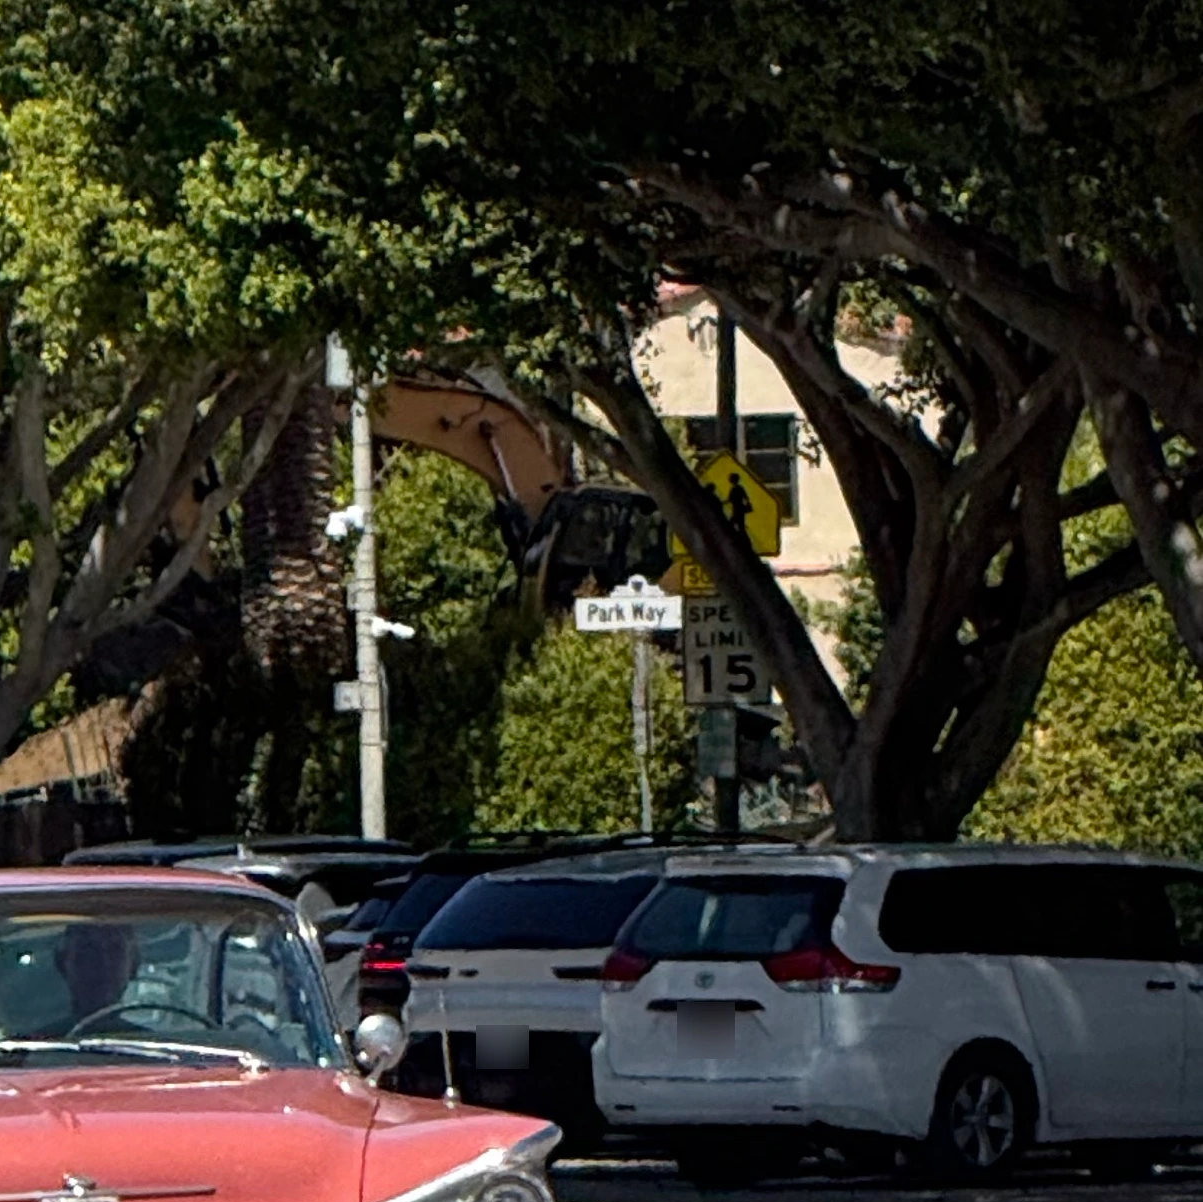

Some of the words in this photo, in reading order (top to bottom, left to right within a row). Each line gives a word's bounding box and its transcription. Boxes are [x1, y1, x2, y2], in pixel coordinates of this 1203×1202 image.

[587, 603, 625, 623] Park
[631, 603, 666, 626] Way
[689, 605, 731, 623] SPE
[695, 631, 744, 648] LIMI
[699, 654, 756, 693] 15
